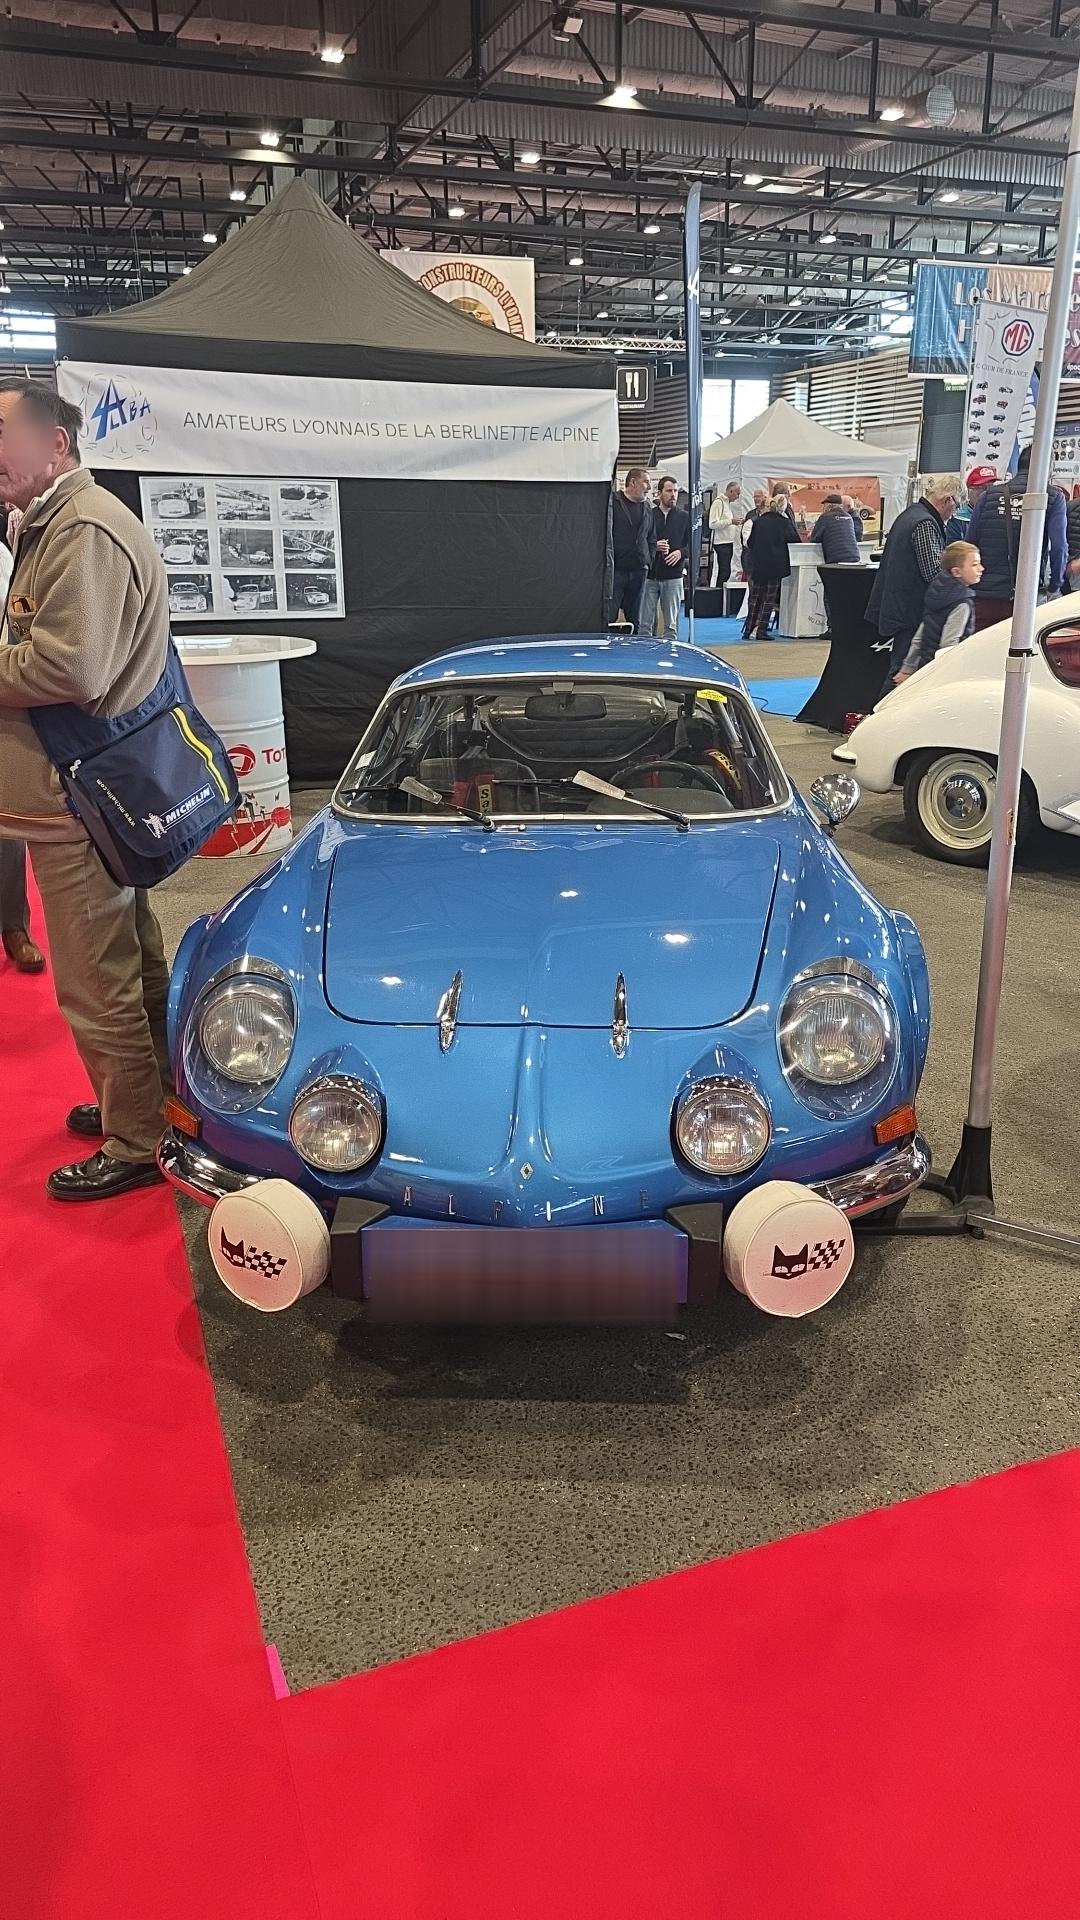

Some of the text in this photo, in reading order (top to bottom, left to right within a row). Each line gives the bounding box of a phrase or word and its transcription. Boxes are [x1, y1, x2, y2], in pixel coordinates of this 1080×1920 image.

[418, 262, 504, 297] ONSTRUCTEURS
[1004, 323, 1031, 352] MG
[183, 411, 600, 442] AMATEURS LYONNAIS DE LA BERLINETTE ALPINE
[166, 787, 211, 824] MICHELIN
